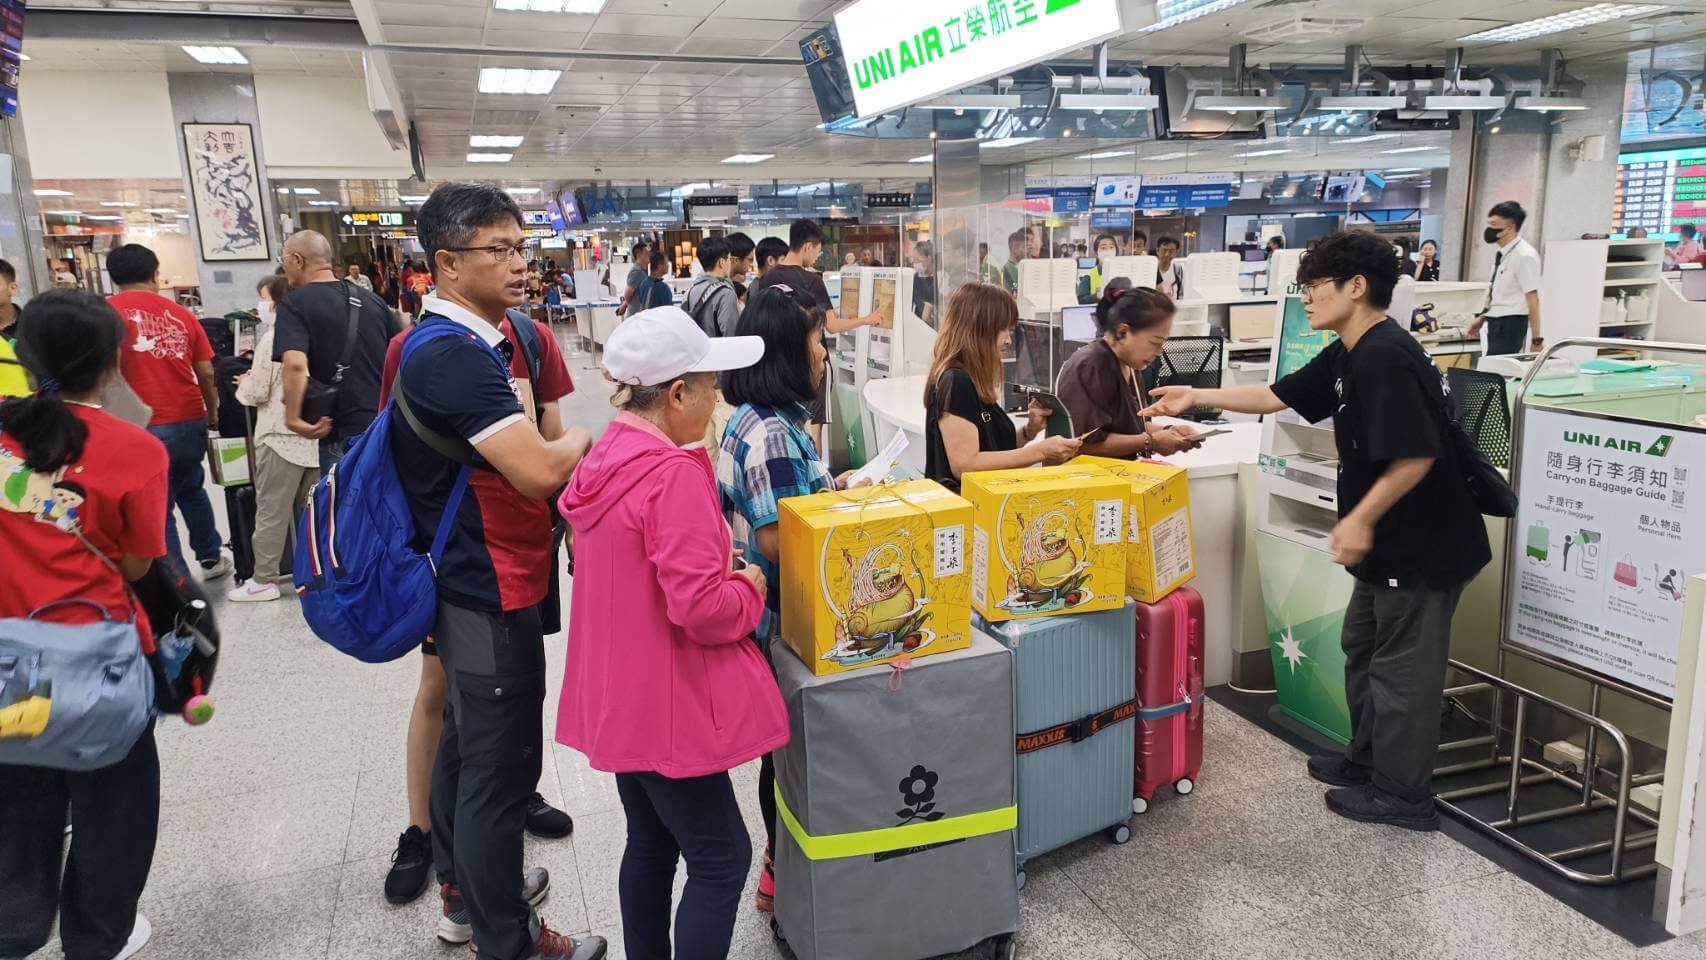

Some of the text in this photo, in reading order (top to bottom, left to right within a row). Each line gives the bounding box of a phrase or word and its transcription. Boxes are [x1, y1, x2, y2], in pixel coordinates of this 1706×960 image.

[854, 48, 895, 89] UNI
[900, 26, 944, 74] AIR
[1563, 431, 1642, 454] UNI AIR
[1547, 451, 1668, 489] 隨身行李須知
[1546, 470, 1586, 485] Carry-on
[1589, 478, 1633, 496] Baggage
[1636, 486, 1667, 501] Guide
[1547, 494, 1584, 510] 手提行李
[1105, 505, 1117, 538] 李子柒
[1638, 525, 1665, 538] Personal
[1639, 514, 1681, 533] 個人物品
[947, 532, 959, 568] 李子柒
[1017, 729, 1064, 749] MAXXIS
